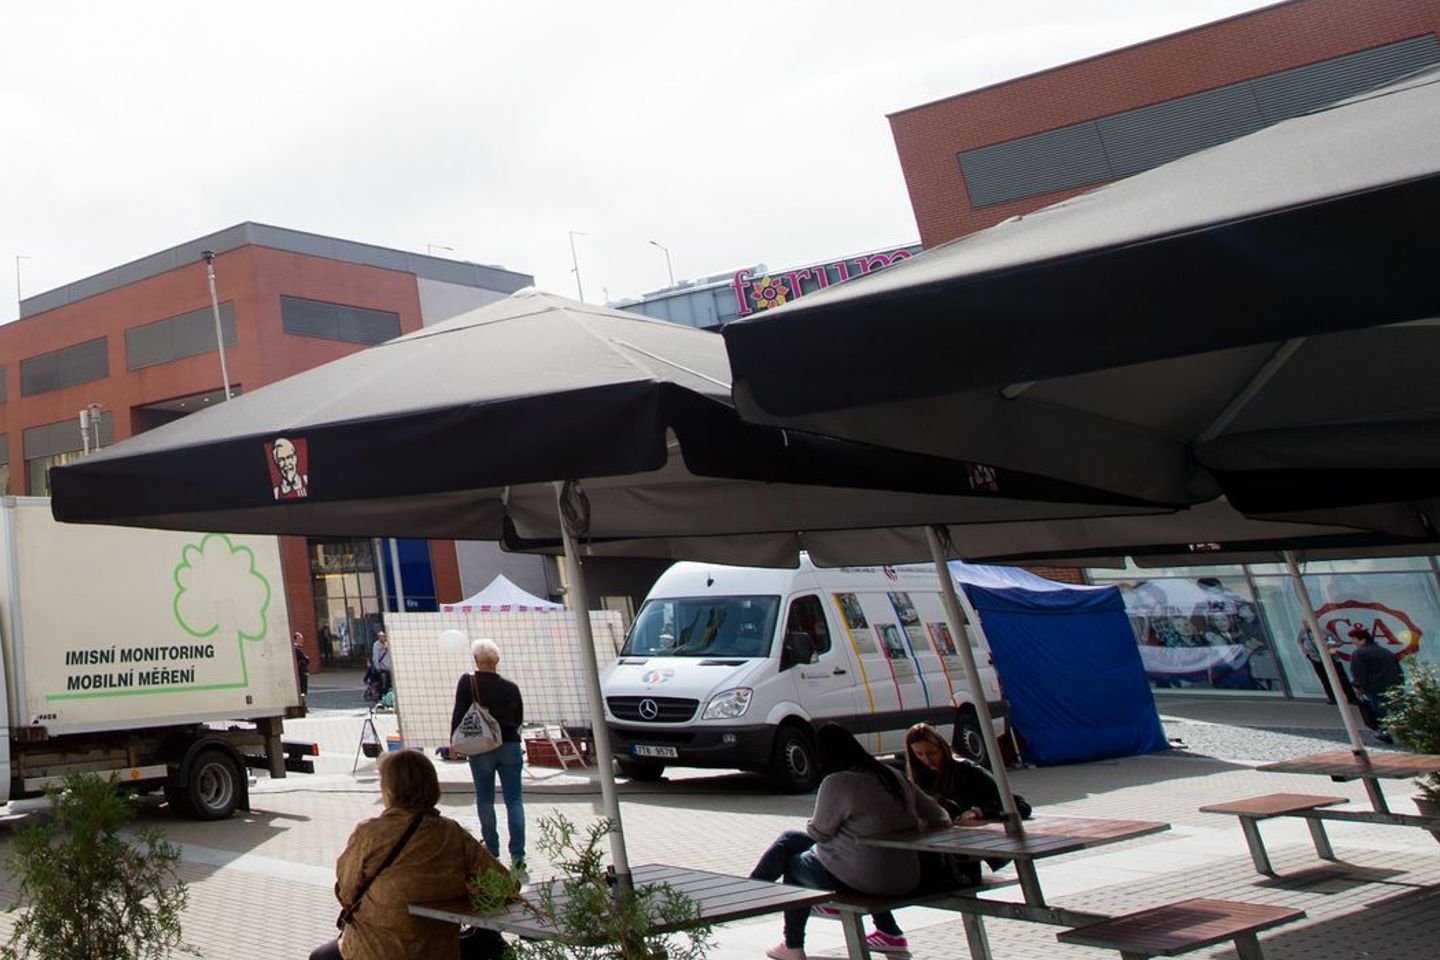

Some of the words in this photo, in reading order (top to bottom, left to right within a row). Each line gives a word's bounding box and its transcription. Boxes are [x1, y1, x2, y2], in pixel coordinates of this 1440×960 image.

[65, 645, 116, 666] IMISNÍ
[120, 644, 215, 663] MONITORING
[67, 668, 134, 690] MOBILNÍ
[138, 665, 195, 686] MĚŘENÍ
